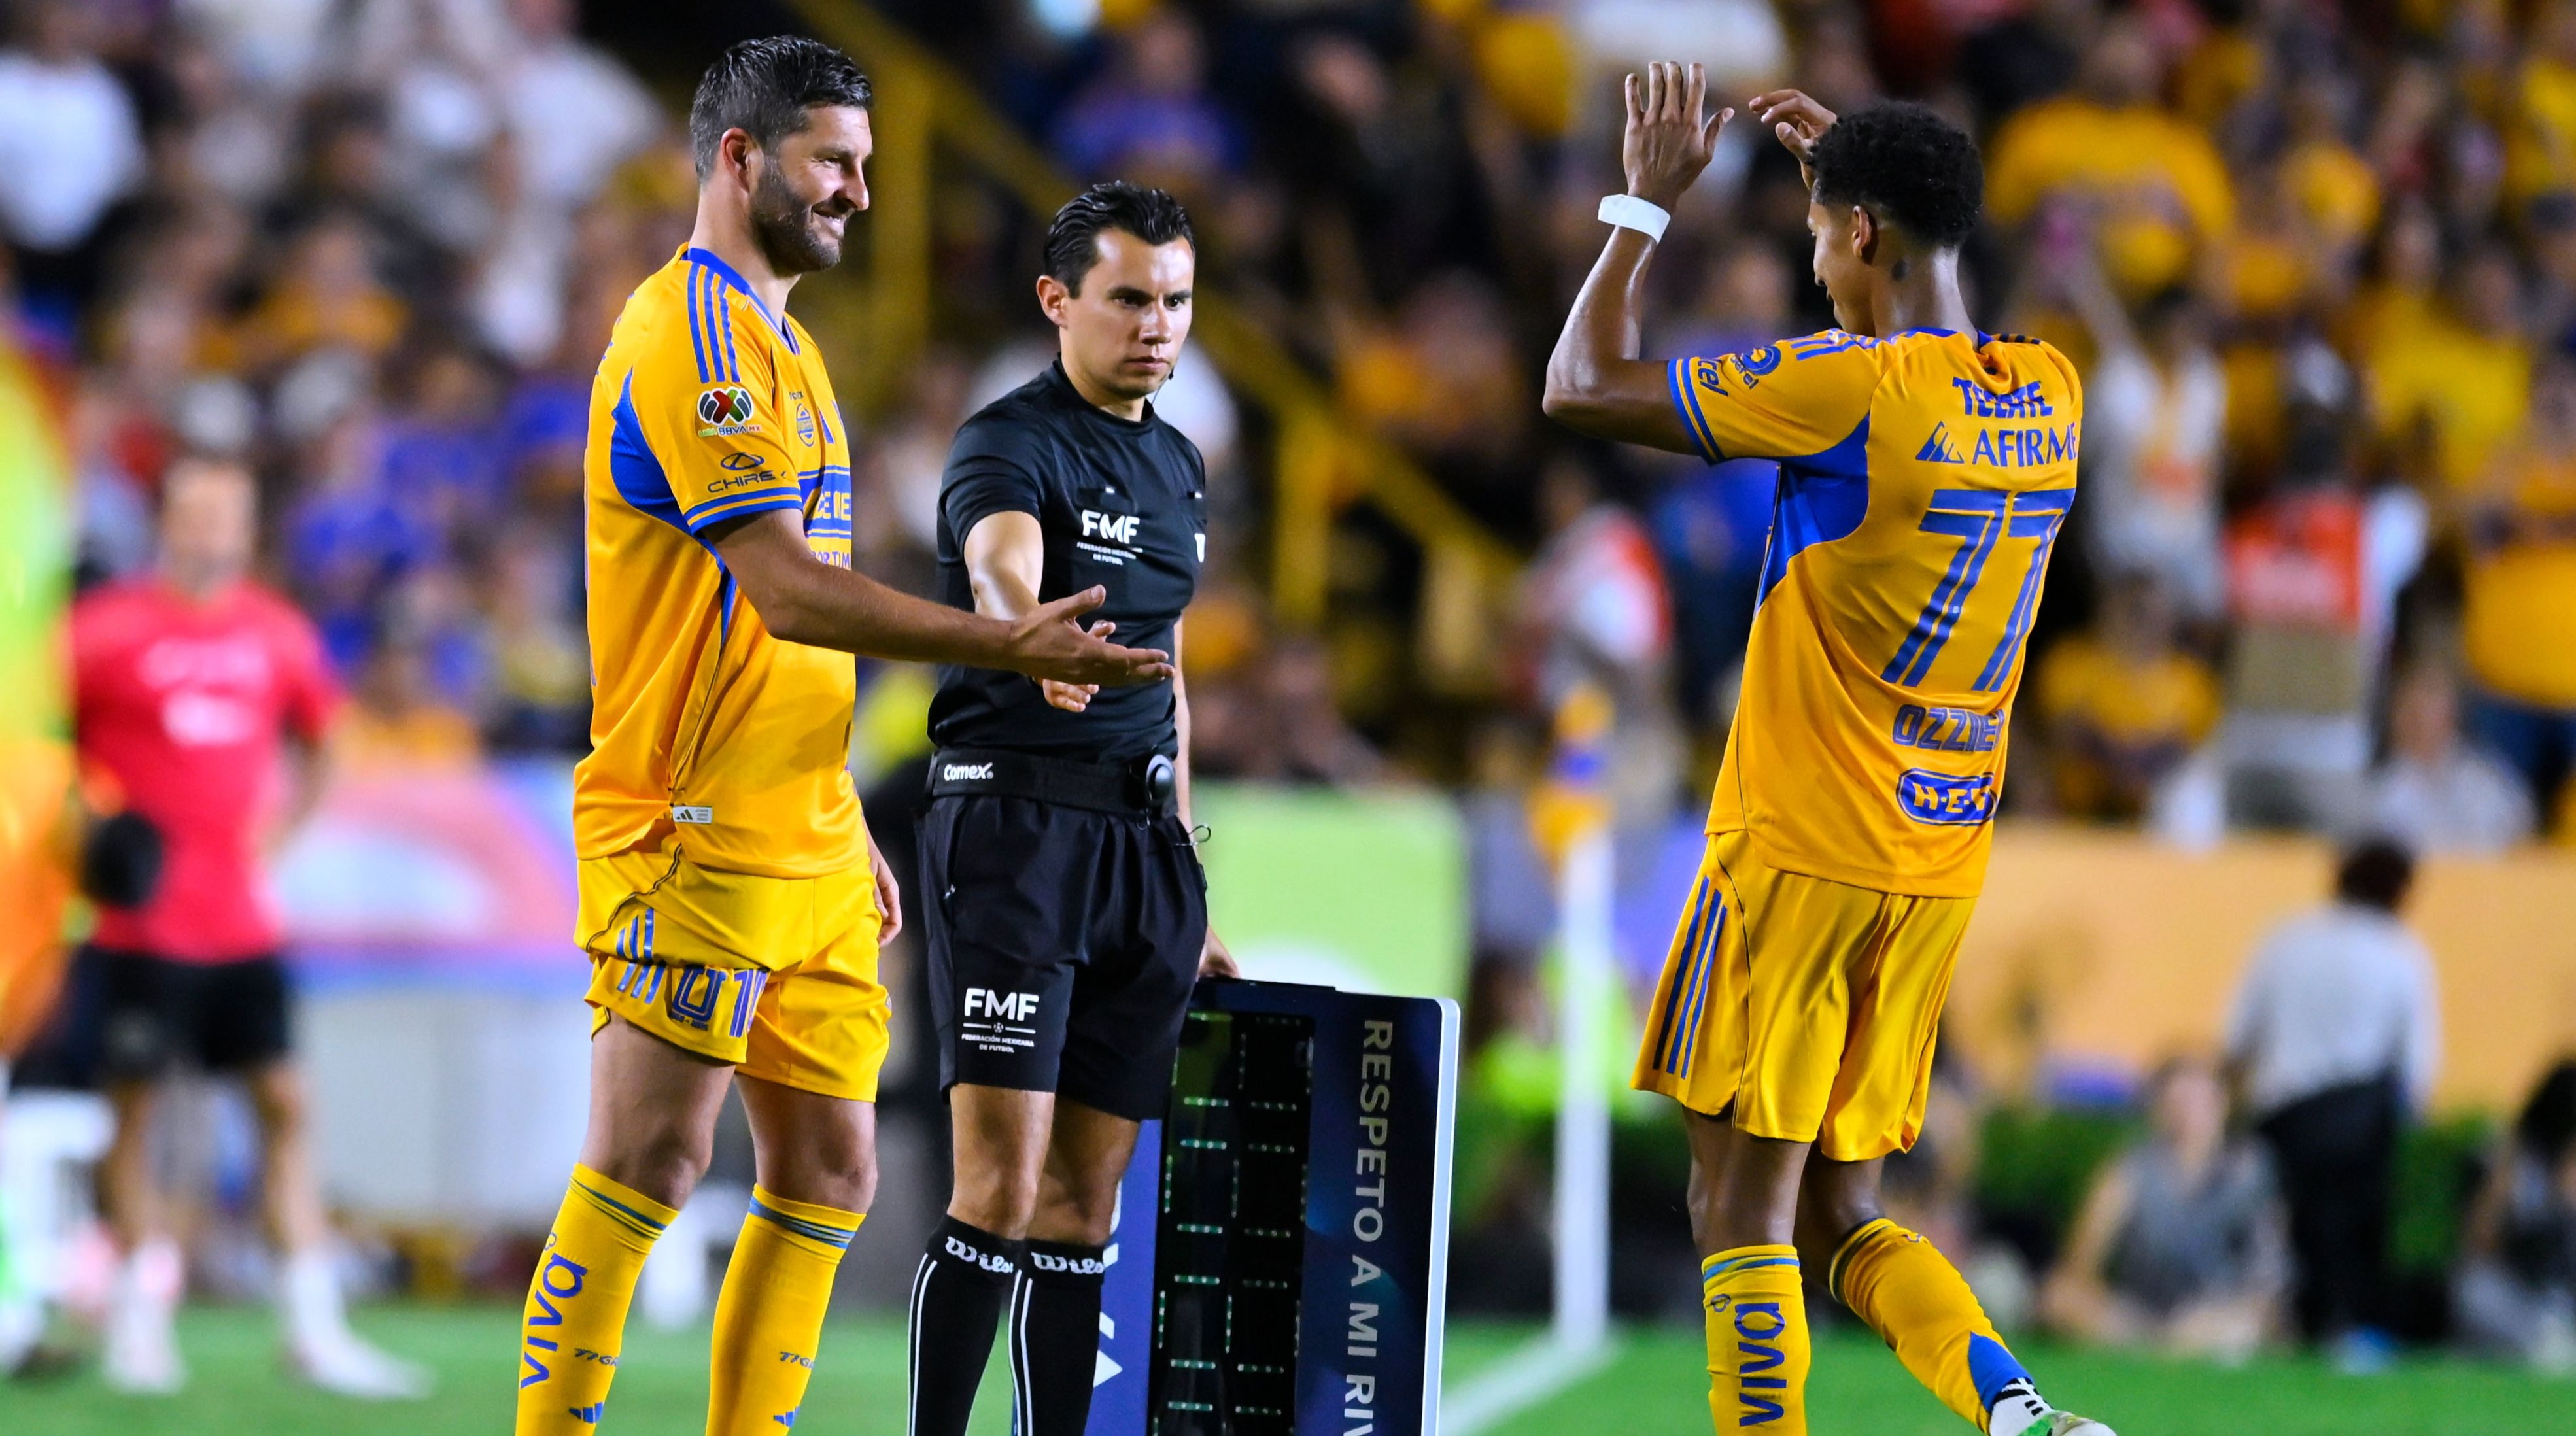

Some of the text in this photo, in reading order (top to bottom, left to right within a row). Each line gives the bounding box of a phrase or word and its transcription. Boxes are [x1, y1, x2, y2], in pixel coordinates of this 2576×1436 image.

[718, 426, 747, 436] BBVA
[1081, 509, 1141, 545] FMF
[1880, 487, 2076, 693] 77
[944, 762, 993, 781] Comex
[964, 987, 1040, 1022] FMF
[1354, 1019, 1393, 1242] RESPETO
[1350, 1254, 1381, 1288] A
[520, 1252, 588, 1390] viva
[1348, 1302, 1379, 1357] MI
[1734, 1301, 1787, 1427] viva
